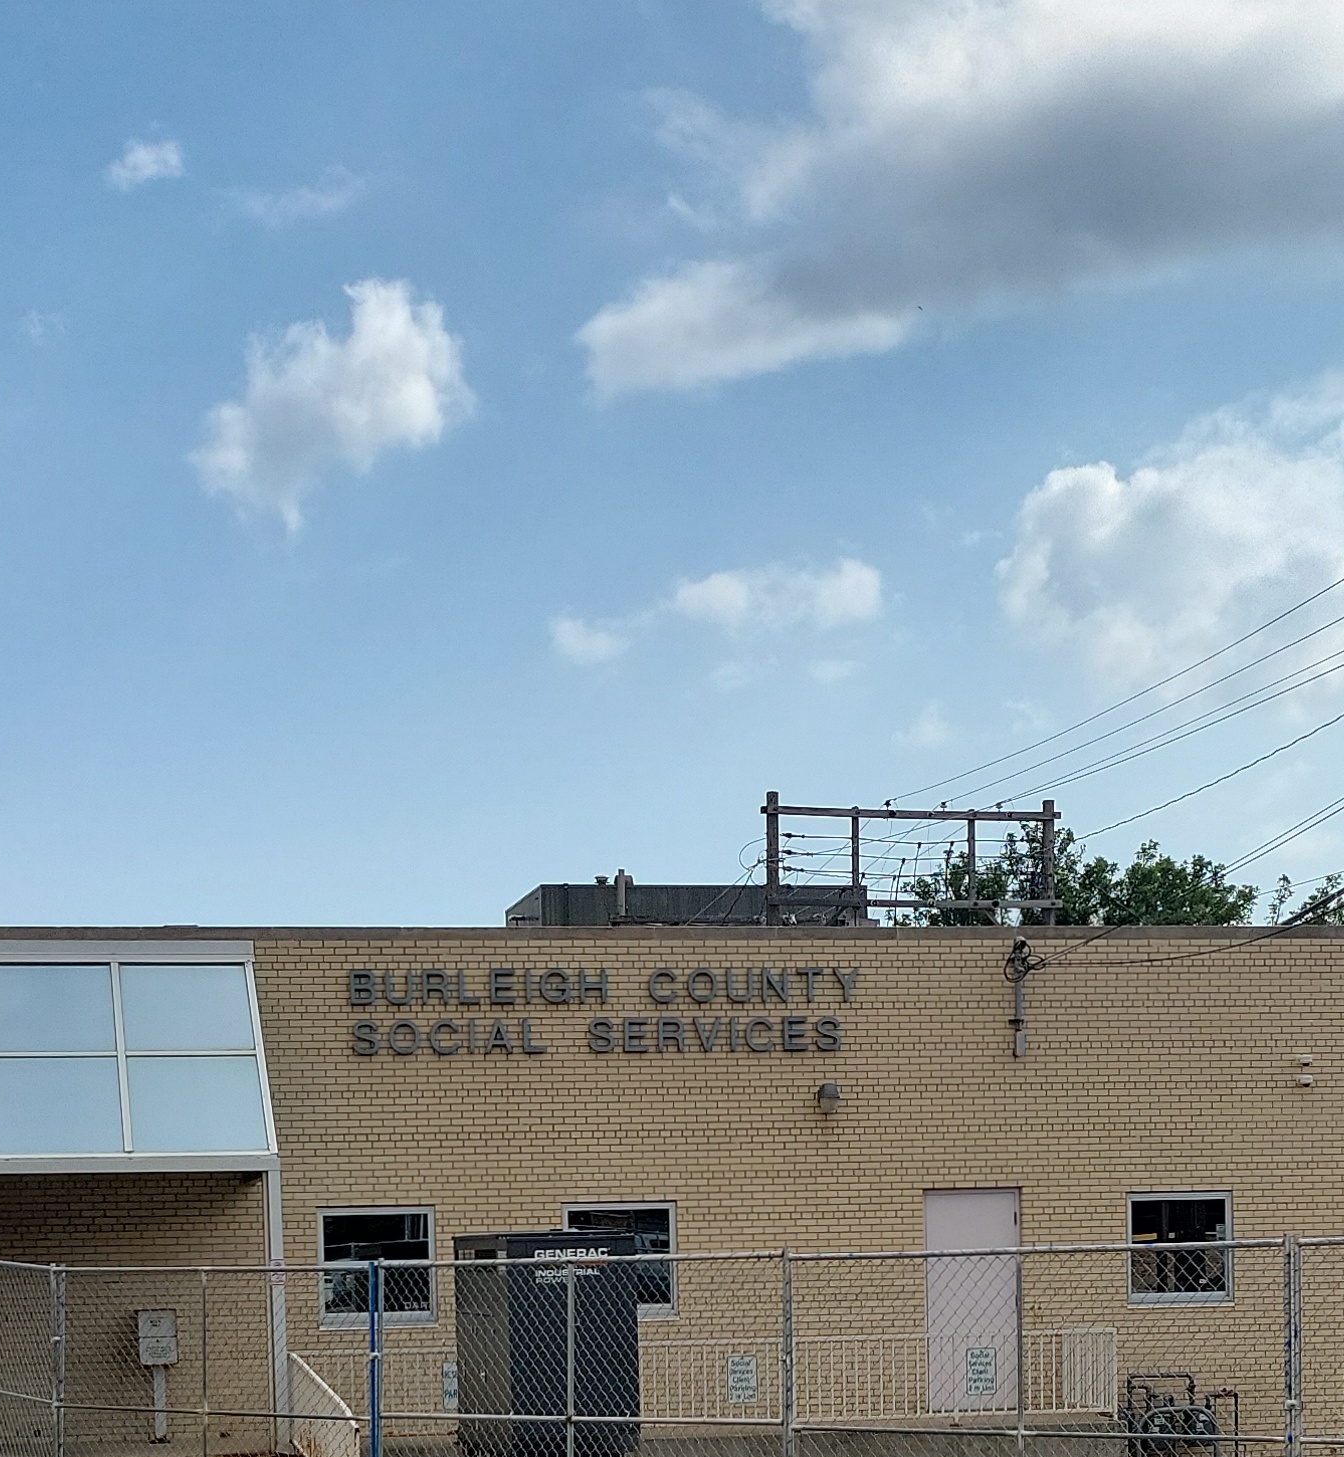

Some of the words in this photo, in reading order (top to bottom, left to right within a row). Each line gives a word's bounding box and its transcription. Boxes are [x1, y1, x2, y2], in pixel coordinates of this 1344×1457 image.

[348, 968, 609, 1006] BURLEIGH
[648, 966, 859, 1004] COUNTY
[352, 1018, 547, 1056] SOCIAL
[589, 1016, 843, 1053] SERVICES
[534, 1247, 609, 1260] GENERAC
